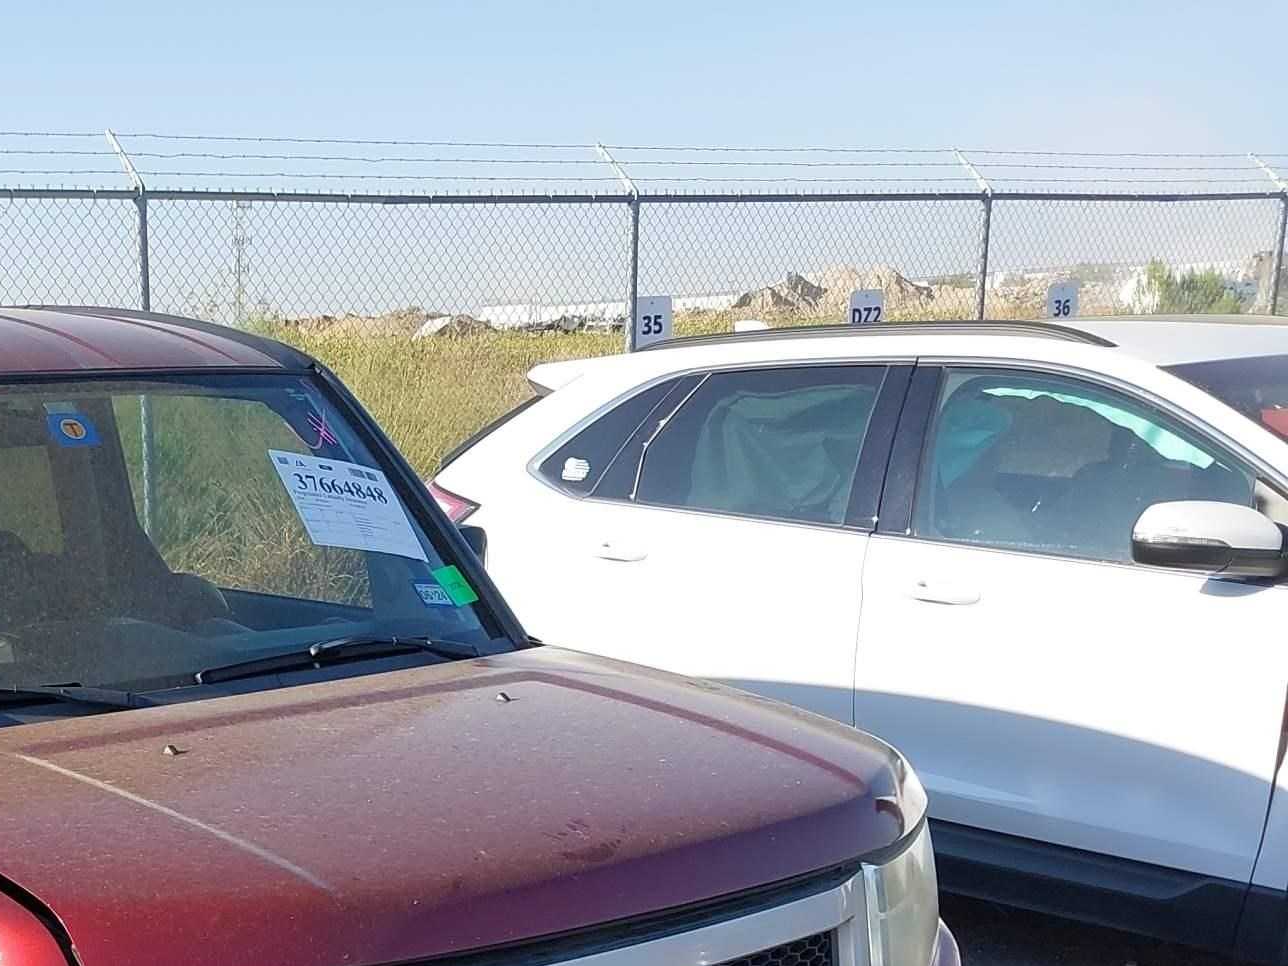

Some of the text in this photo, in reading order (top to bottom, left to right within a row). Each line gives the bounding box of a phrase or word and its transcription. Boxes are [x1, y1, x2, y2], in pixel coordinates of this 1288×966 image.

[851, 306, 882, 324] DZ2
[1052, 298, 1072, 318] 36
[641, 314, 664, 336] 35
[292, 471, 389, 505] 37664848
